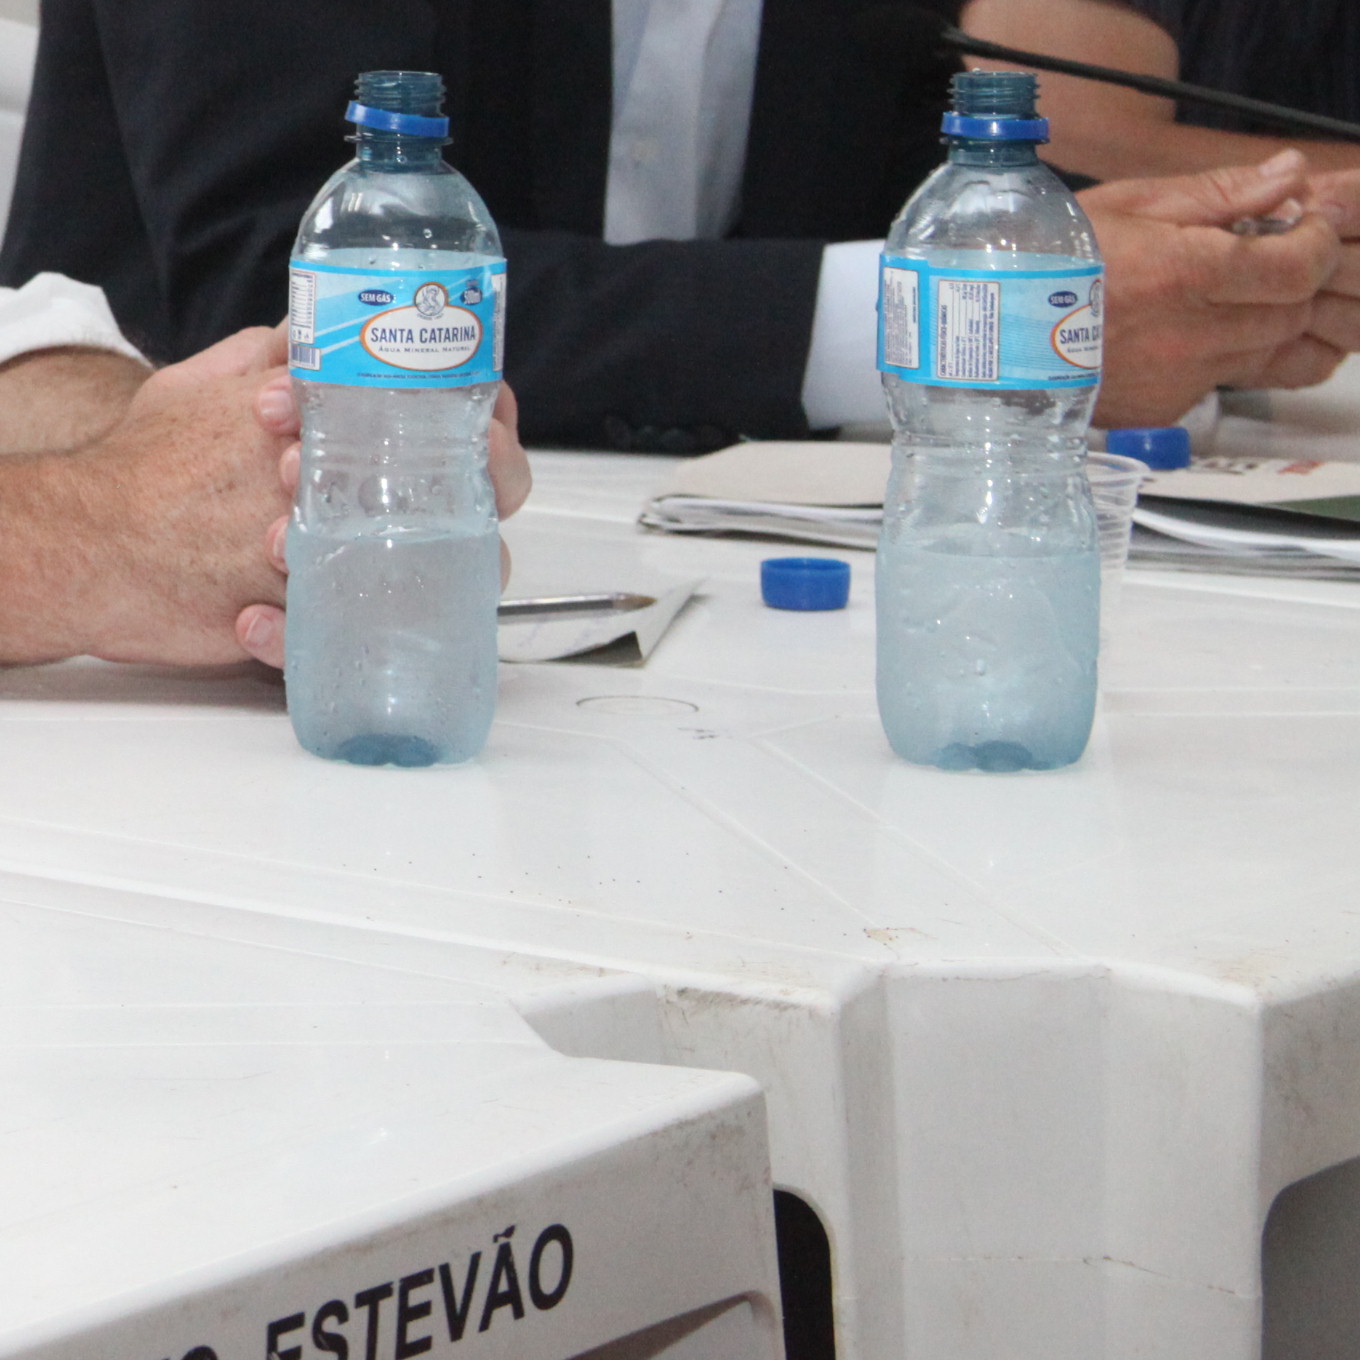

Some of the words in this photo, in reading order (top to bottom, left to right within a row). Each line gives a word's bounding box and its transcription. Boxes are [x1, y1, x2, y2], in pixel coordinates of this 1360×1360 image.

[360, 291, 376, 302] SEM
[376, 291, 391, 303] GÁS
[371, 328, 413, 343] SANTA
[419, 326, 476, 343] CATARINA
[1060, 327, 1089, 345] SANTA
